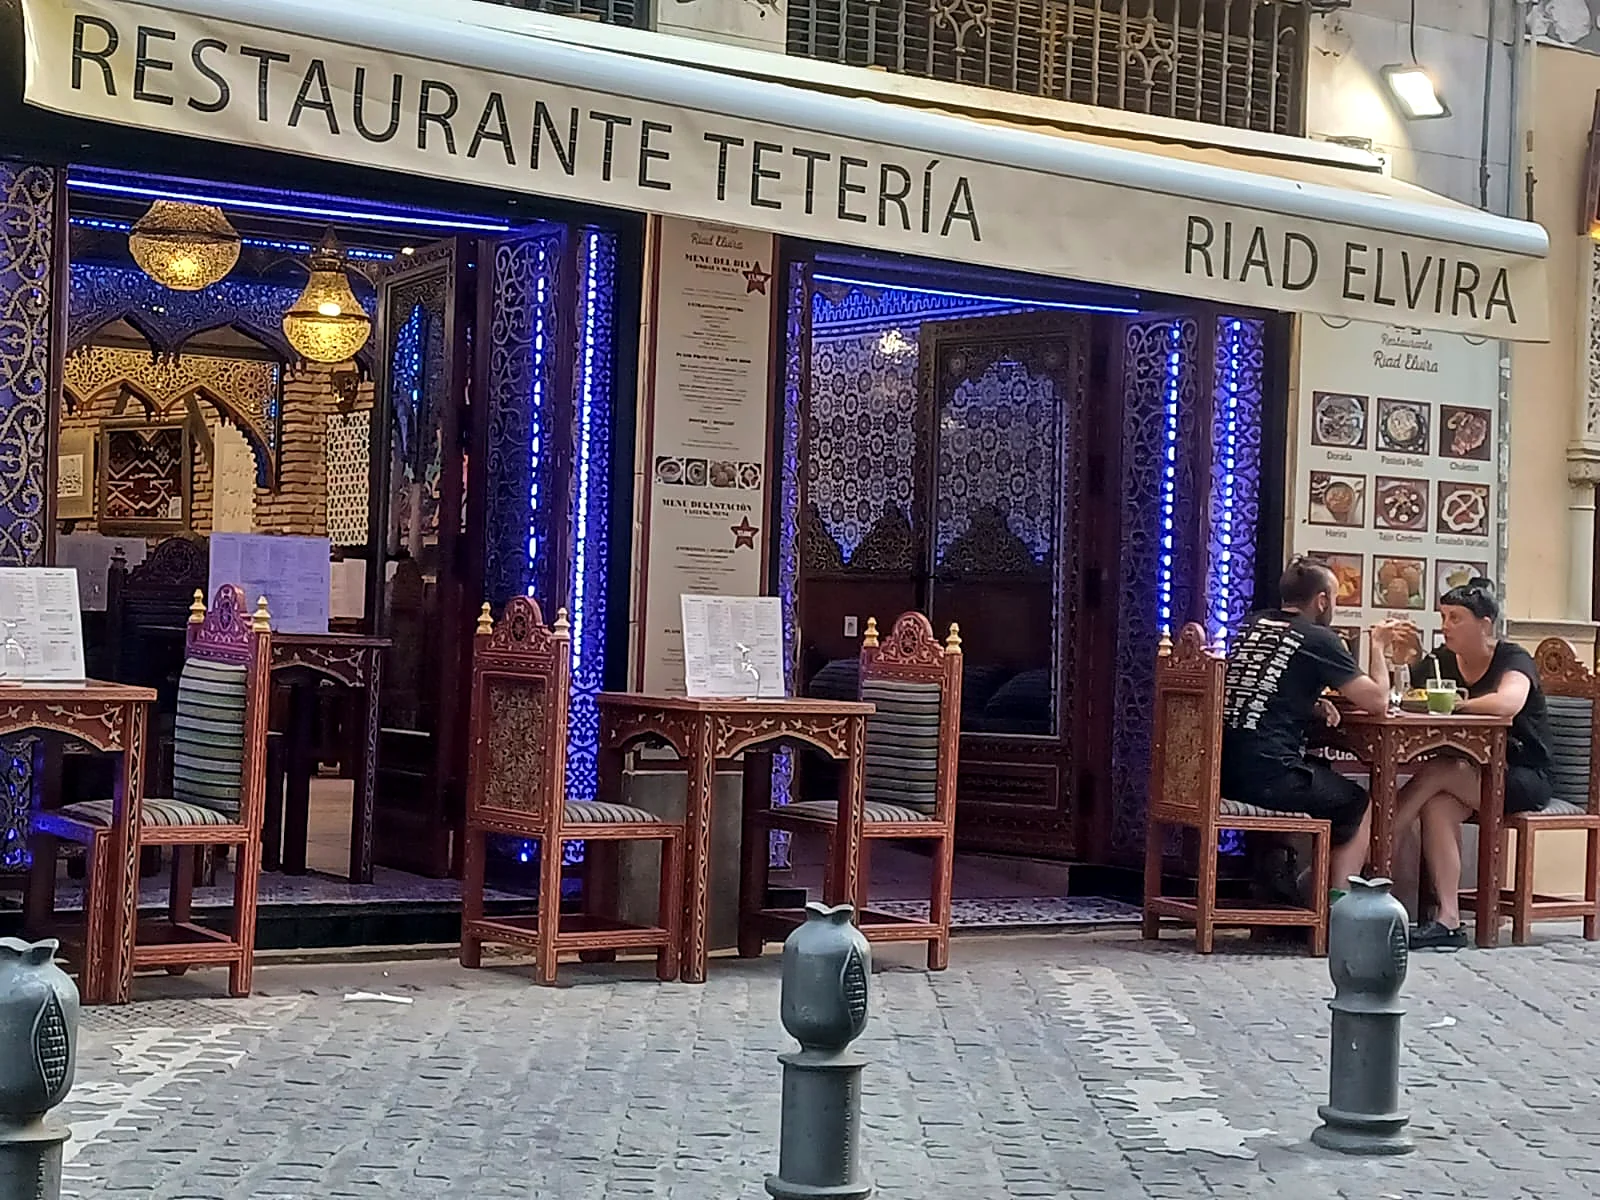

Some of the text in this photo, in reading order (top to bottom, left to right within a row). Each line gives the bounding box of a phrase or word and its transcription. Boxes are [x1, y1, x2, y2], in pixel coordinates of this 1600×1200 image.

[71, 14, 1518, 325] RESTAURANTE TETERÍA RIAD ELVIRA
[1373, 350, 1439, 373] Riad Elvira
